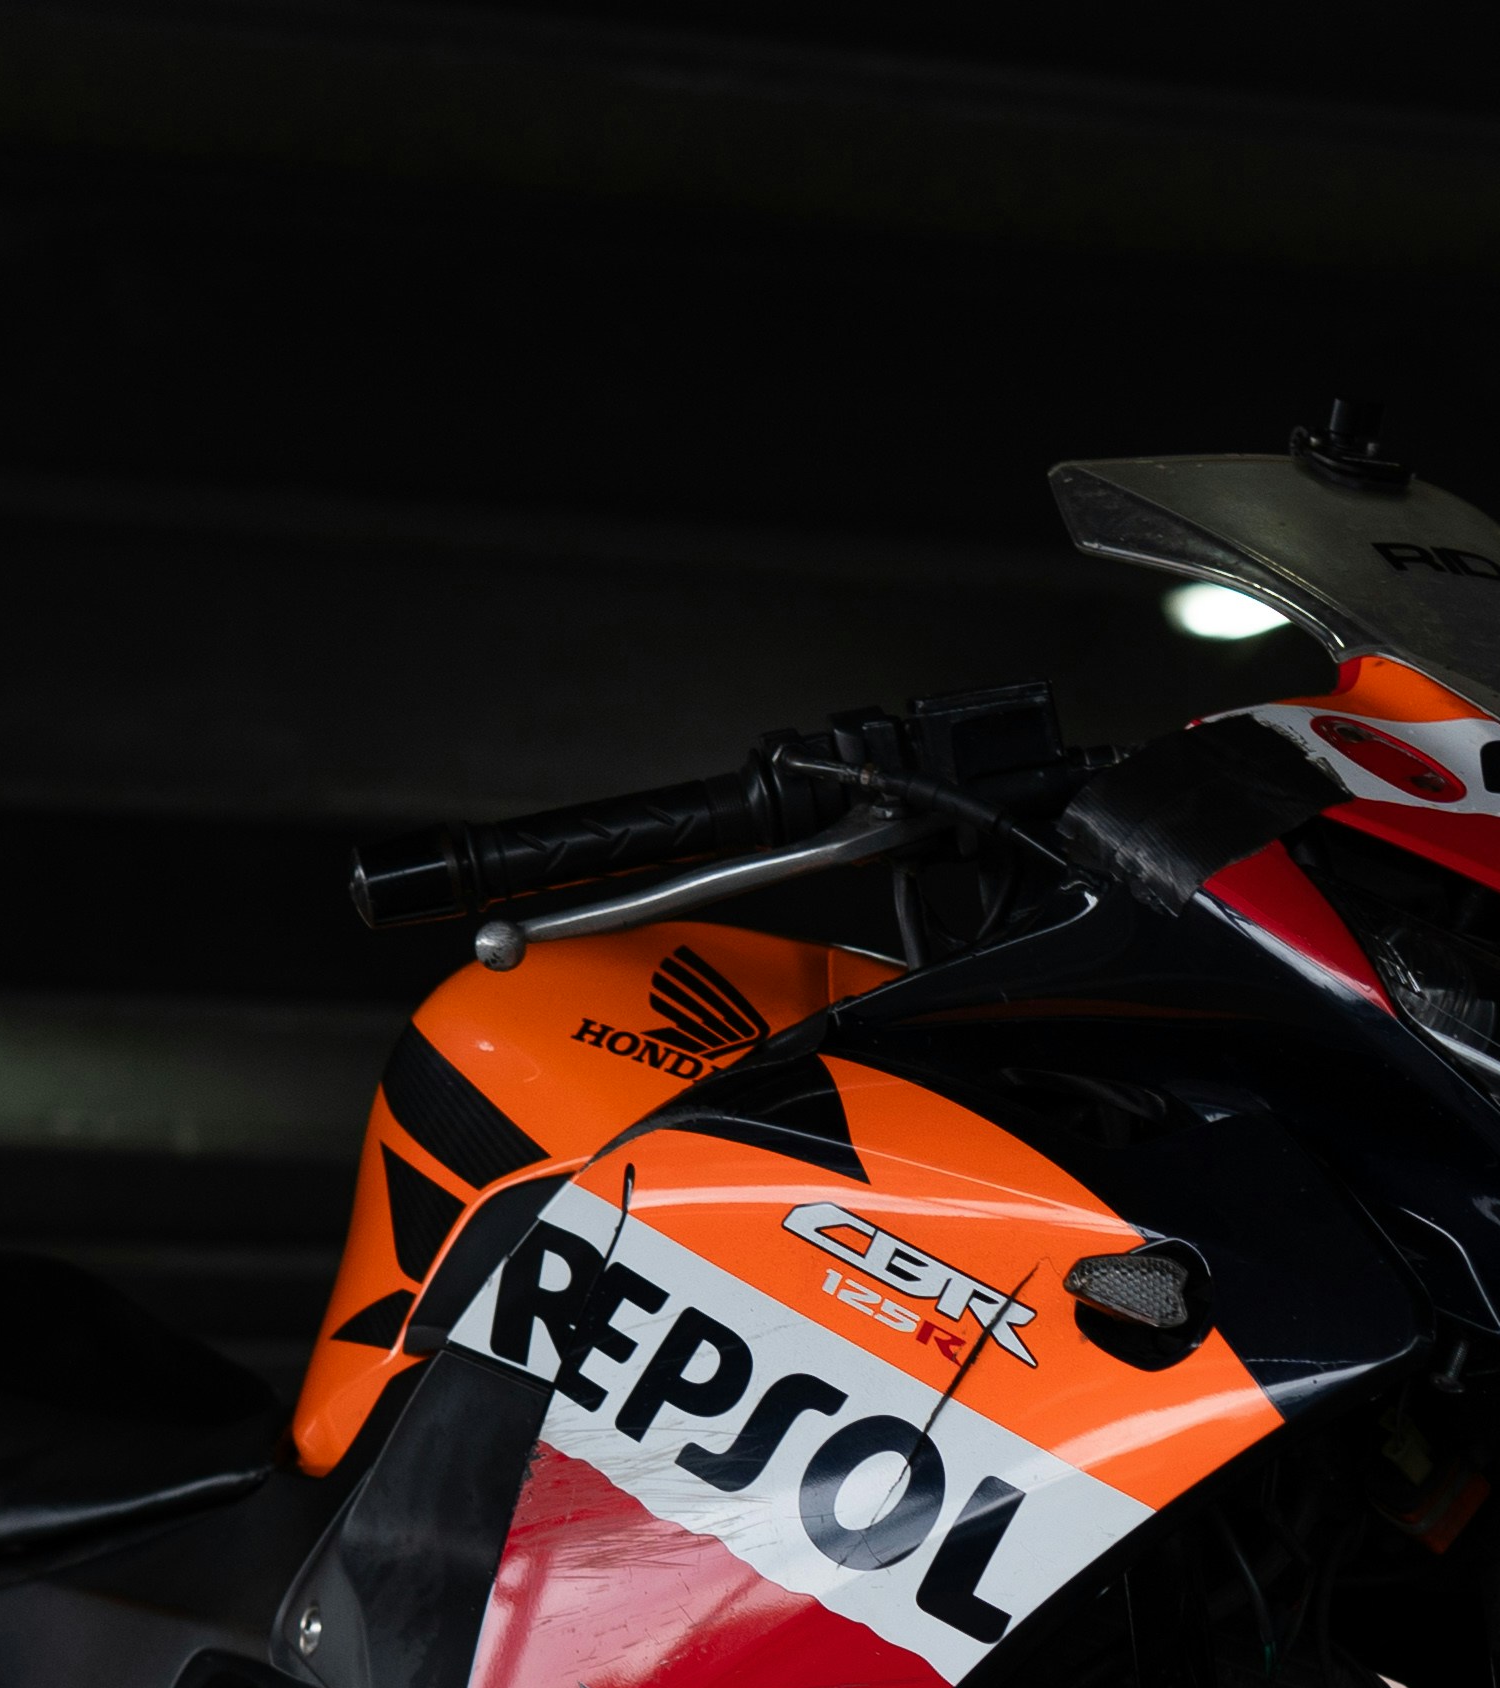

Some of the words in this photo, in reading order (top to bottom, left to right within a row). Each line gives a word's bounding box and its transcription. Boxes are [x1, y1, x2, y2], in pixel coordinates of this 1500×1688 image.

[781, 1200, 1039, 1367] CBR
[820, 1266, 968, 1365] 125R
[489, 1219, 1027, 1644] REPSOL
